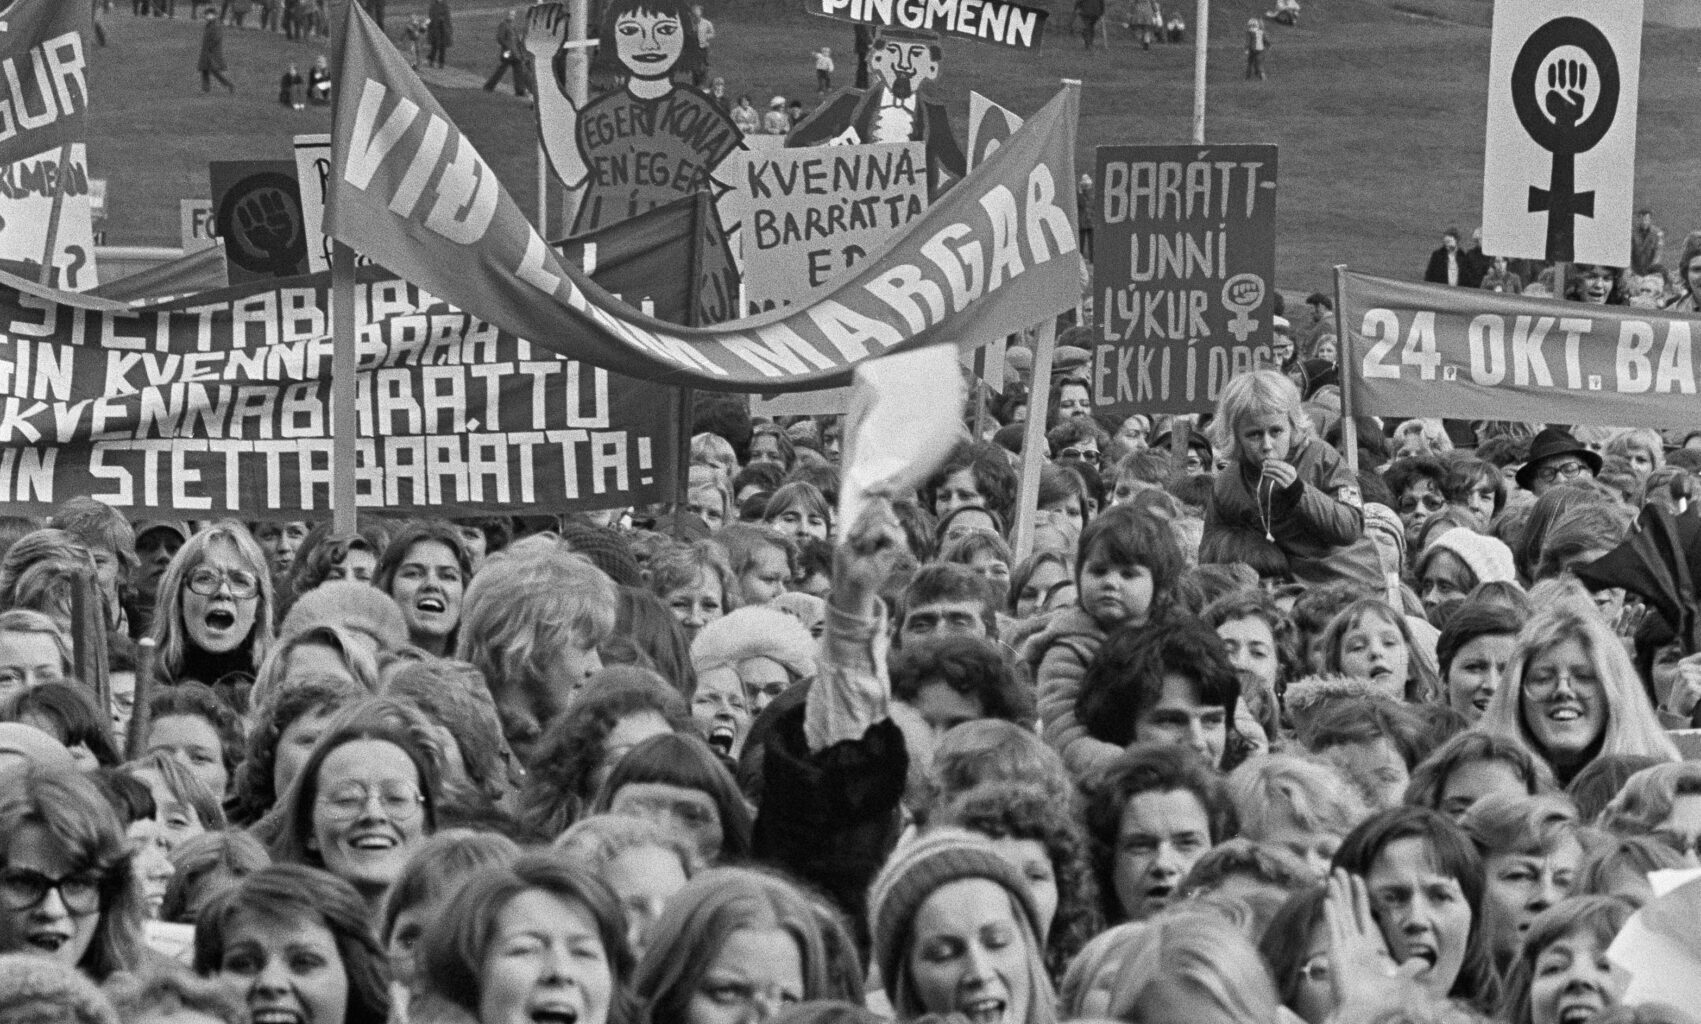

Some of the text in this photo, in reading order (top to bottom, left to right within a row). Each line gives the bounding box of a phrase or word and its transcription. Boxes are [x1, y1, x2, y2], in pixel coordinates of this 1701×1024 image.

[748, 148, 926, 198] KVENNA-
[717, 162, 1076, 377] MARGAR
[1094, 344, 1171, 406] EKKI
[1361, 307, 1697, 395] 24. OKT. BA
